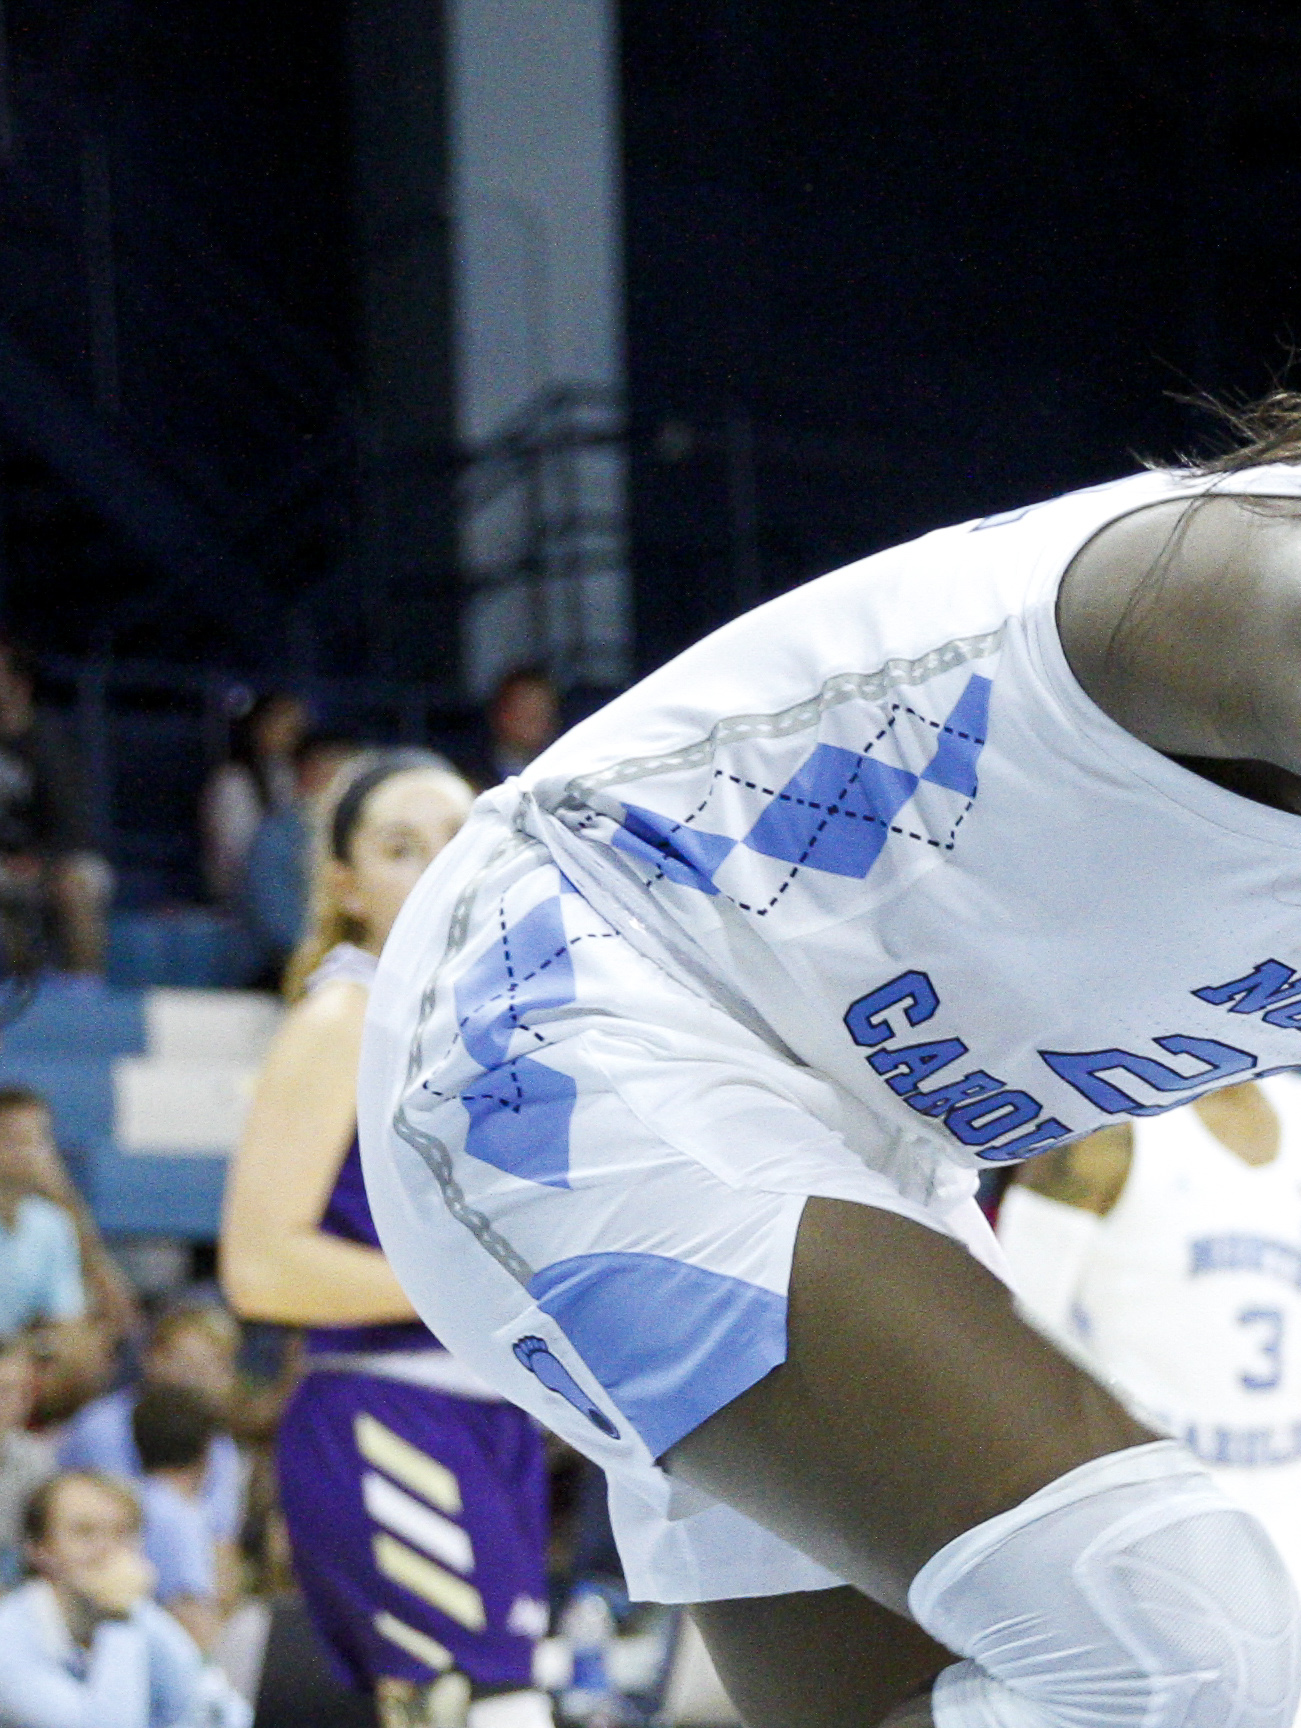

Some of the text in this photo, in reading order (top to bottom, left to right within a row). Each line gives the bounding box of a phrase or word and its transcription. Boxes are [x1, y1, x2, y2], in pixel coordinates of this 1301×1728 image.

[843, 969, 1074, 1162] CAROL
[1036, 1033, 1257, 1117] 2
[1236, 1308, 1283, 1390] 3
